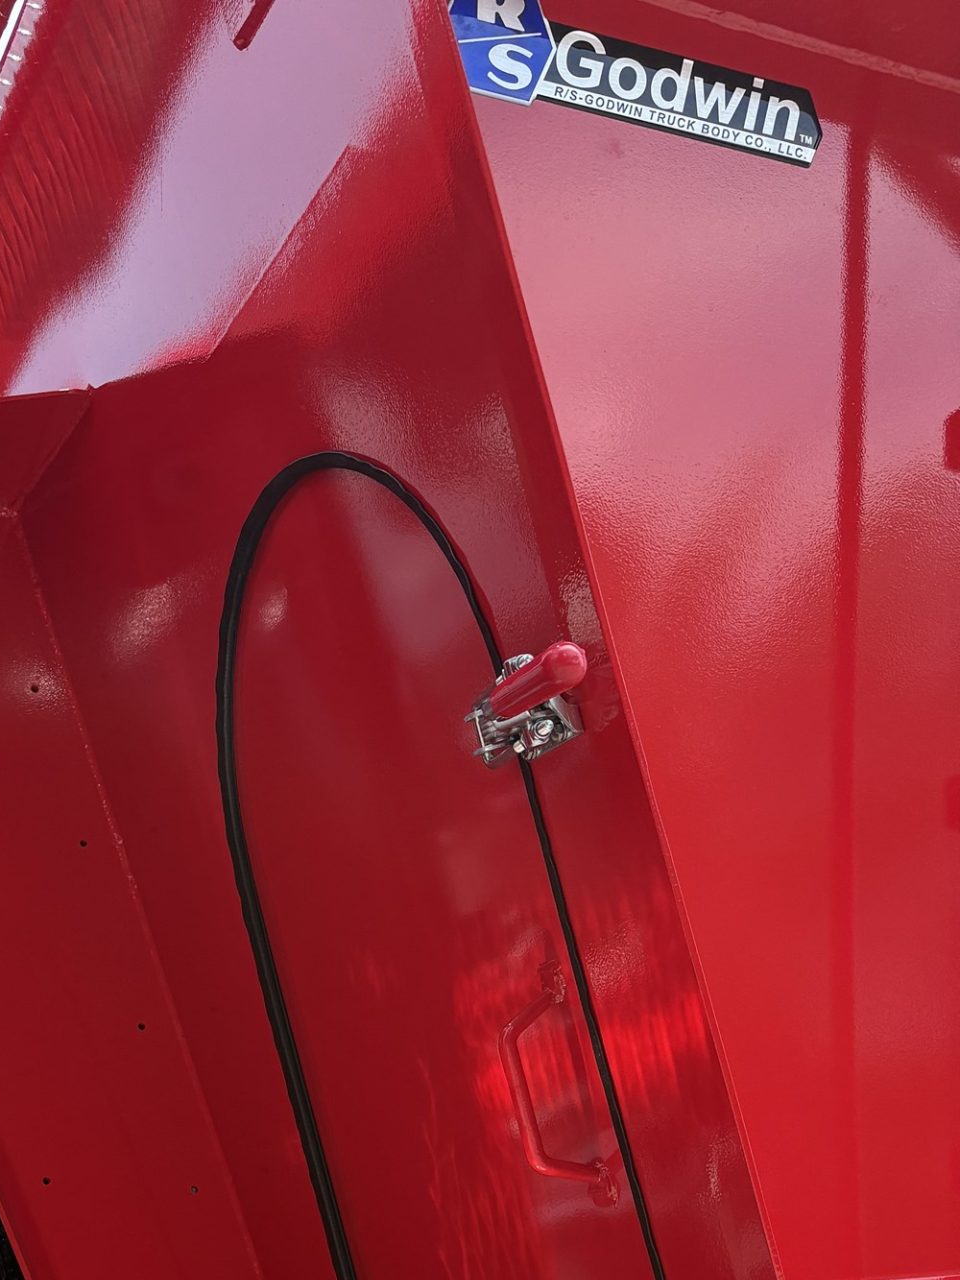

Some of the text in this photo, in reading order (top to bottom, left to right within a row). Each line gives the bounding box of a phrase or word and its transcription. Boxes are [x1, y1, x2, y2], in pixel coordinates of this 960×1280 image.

[487, 43, 533, 91] S
[556, 30, 800, 141] Godwin
[554, 86, 807, 160] R/S-GODWIN TRUCK BODY CO., LLC.
